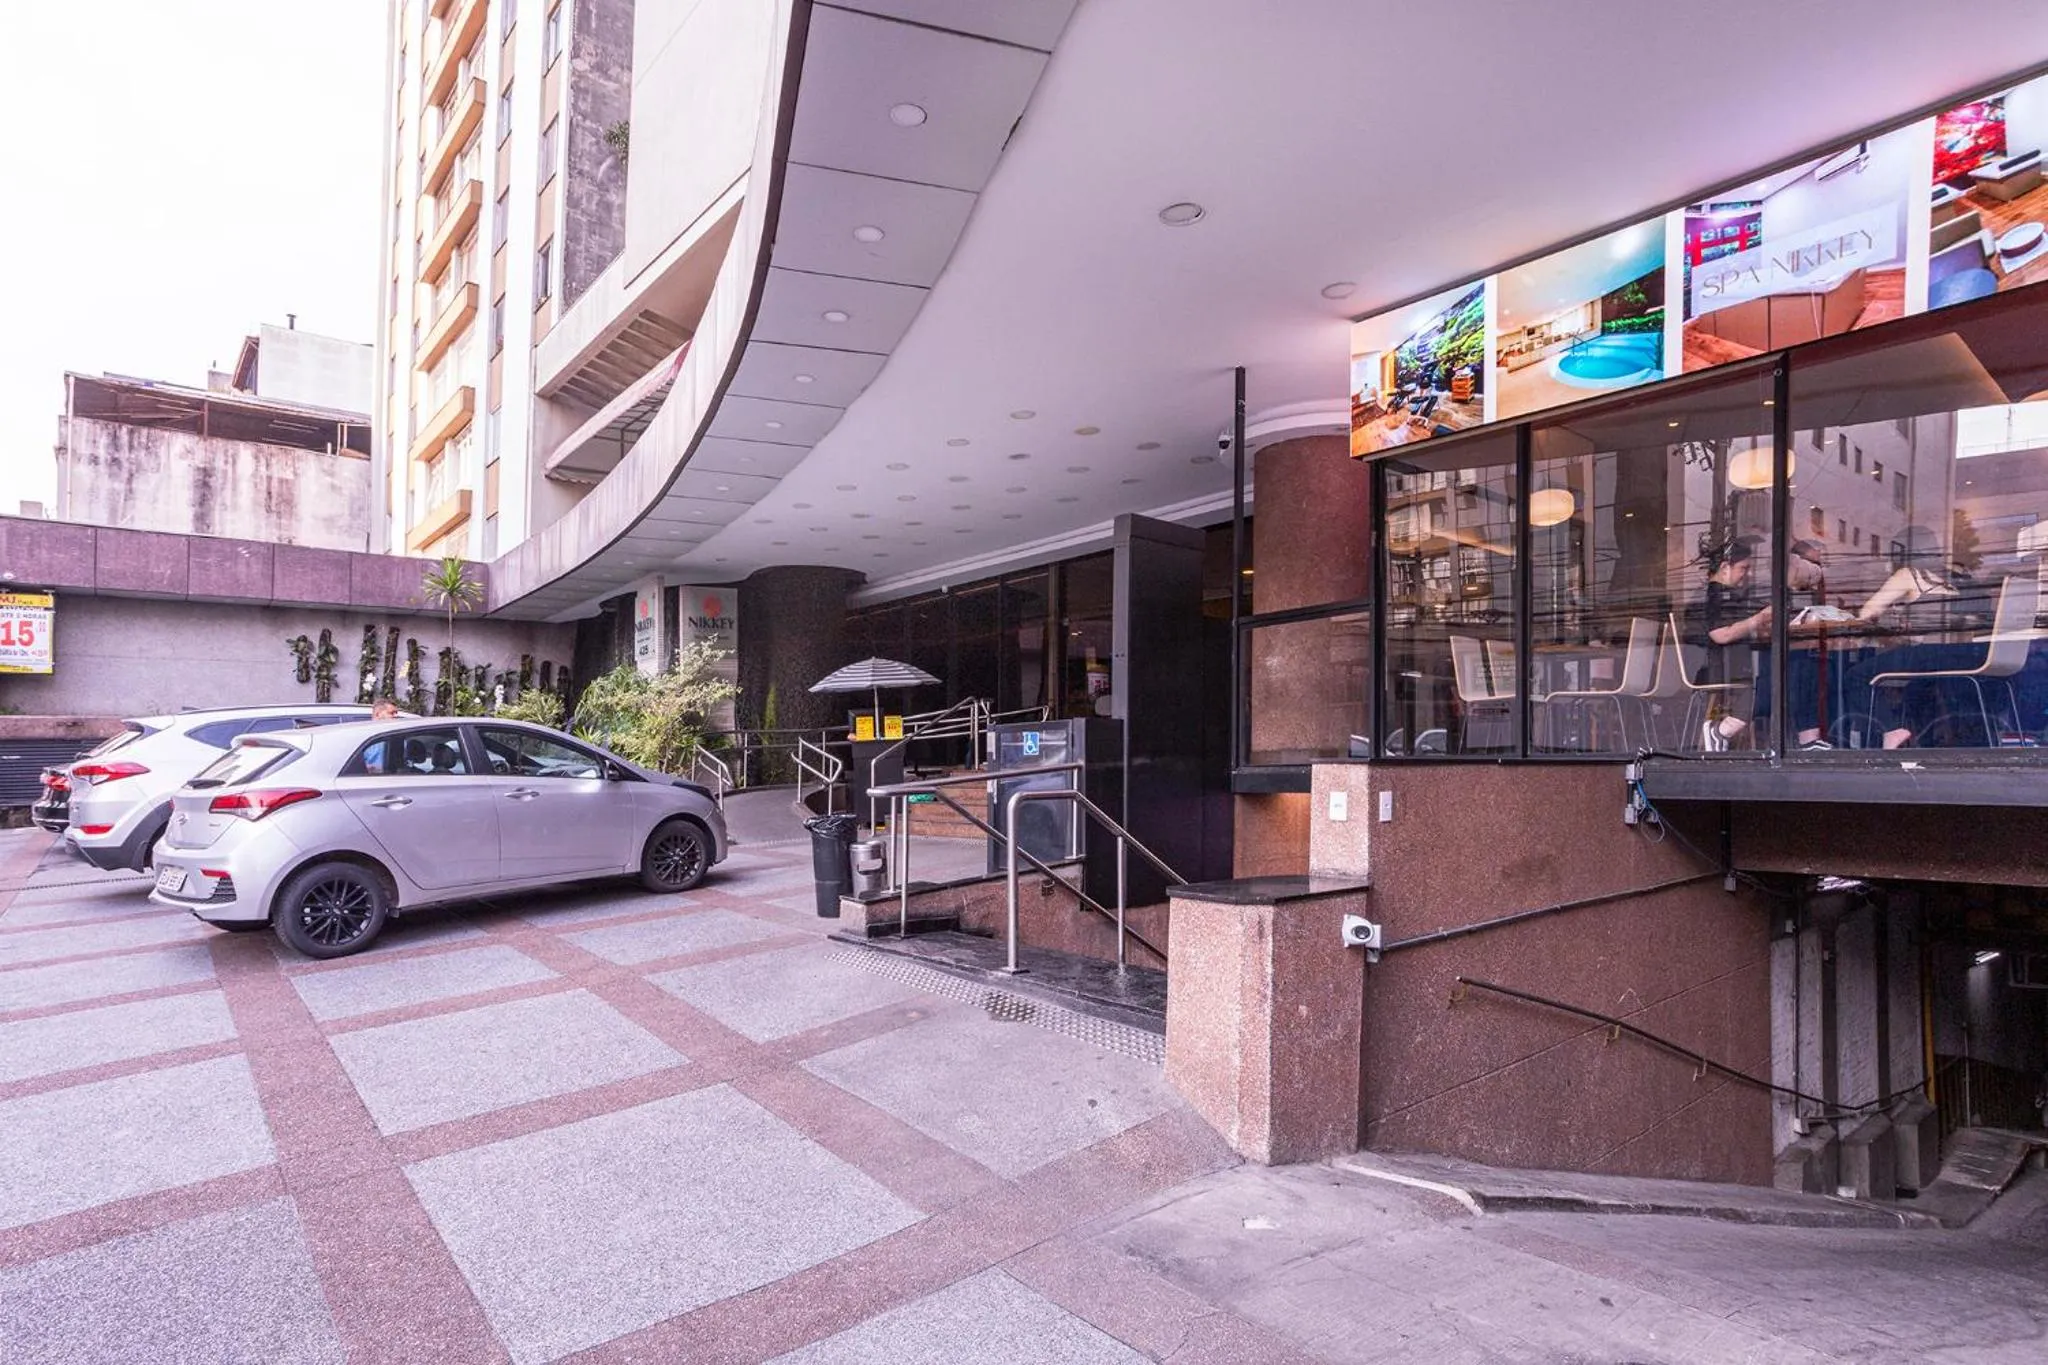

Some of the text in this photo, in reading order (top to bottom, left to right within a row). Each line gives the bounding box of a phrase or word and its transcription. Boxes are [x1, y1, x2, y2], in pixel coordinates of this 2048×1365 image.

[1702, 229, 1879, 299] SPA NIKKEY
[0, 620, 35, 646] 15
[688, 615, 735, 629] NIKKEY
